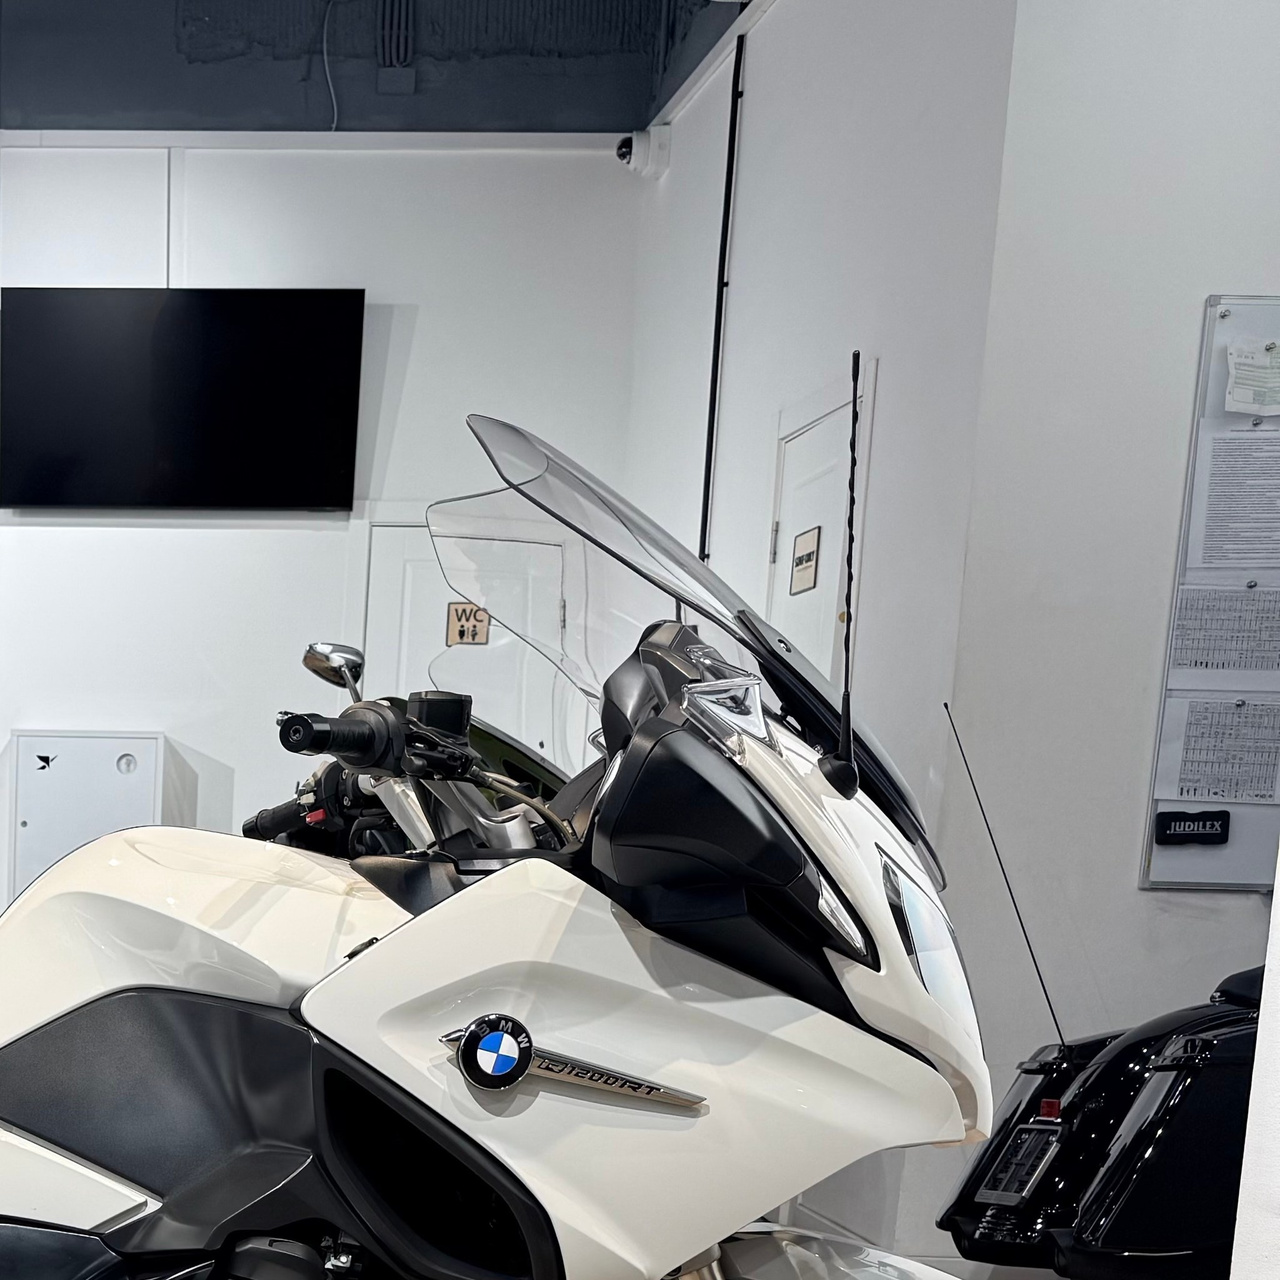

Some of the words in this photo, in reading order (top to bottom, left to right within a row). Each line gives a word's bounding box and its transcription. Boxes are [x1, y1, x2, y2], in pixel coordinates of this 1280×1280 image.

[454, 607, 488, 623] WC
[1170, 820, 1222, 834] JUDILEX
[476, 1019, 530, 1049] BMW
